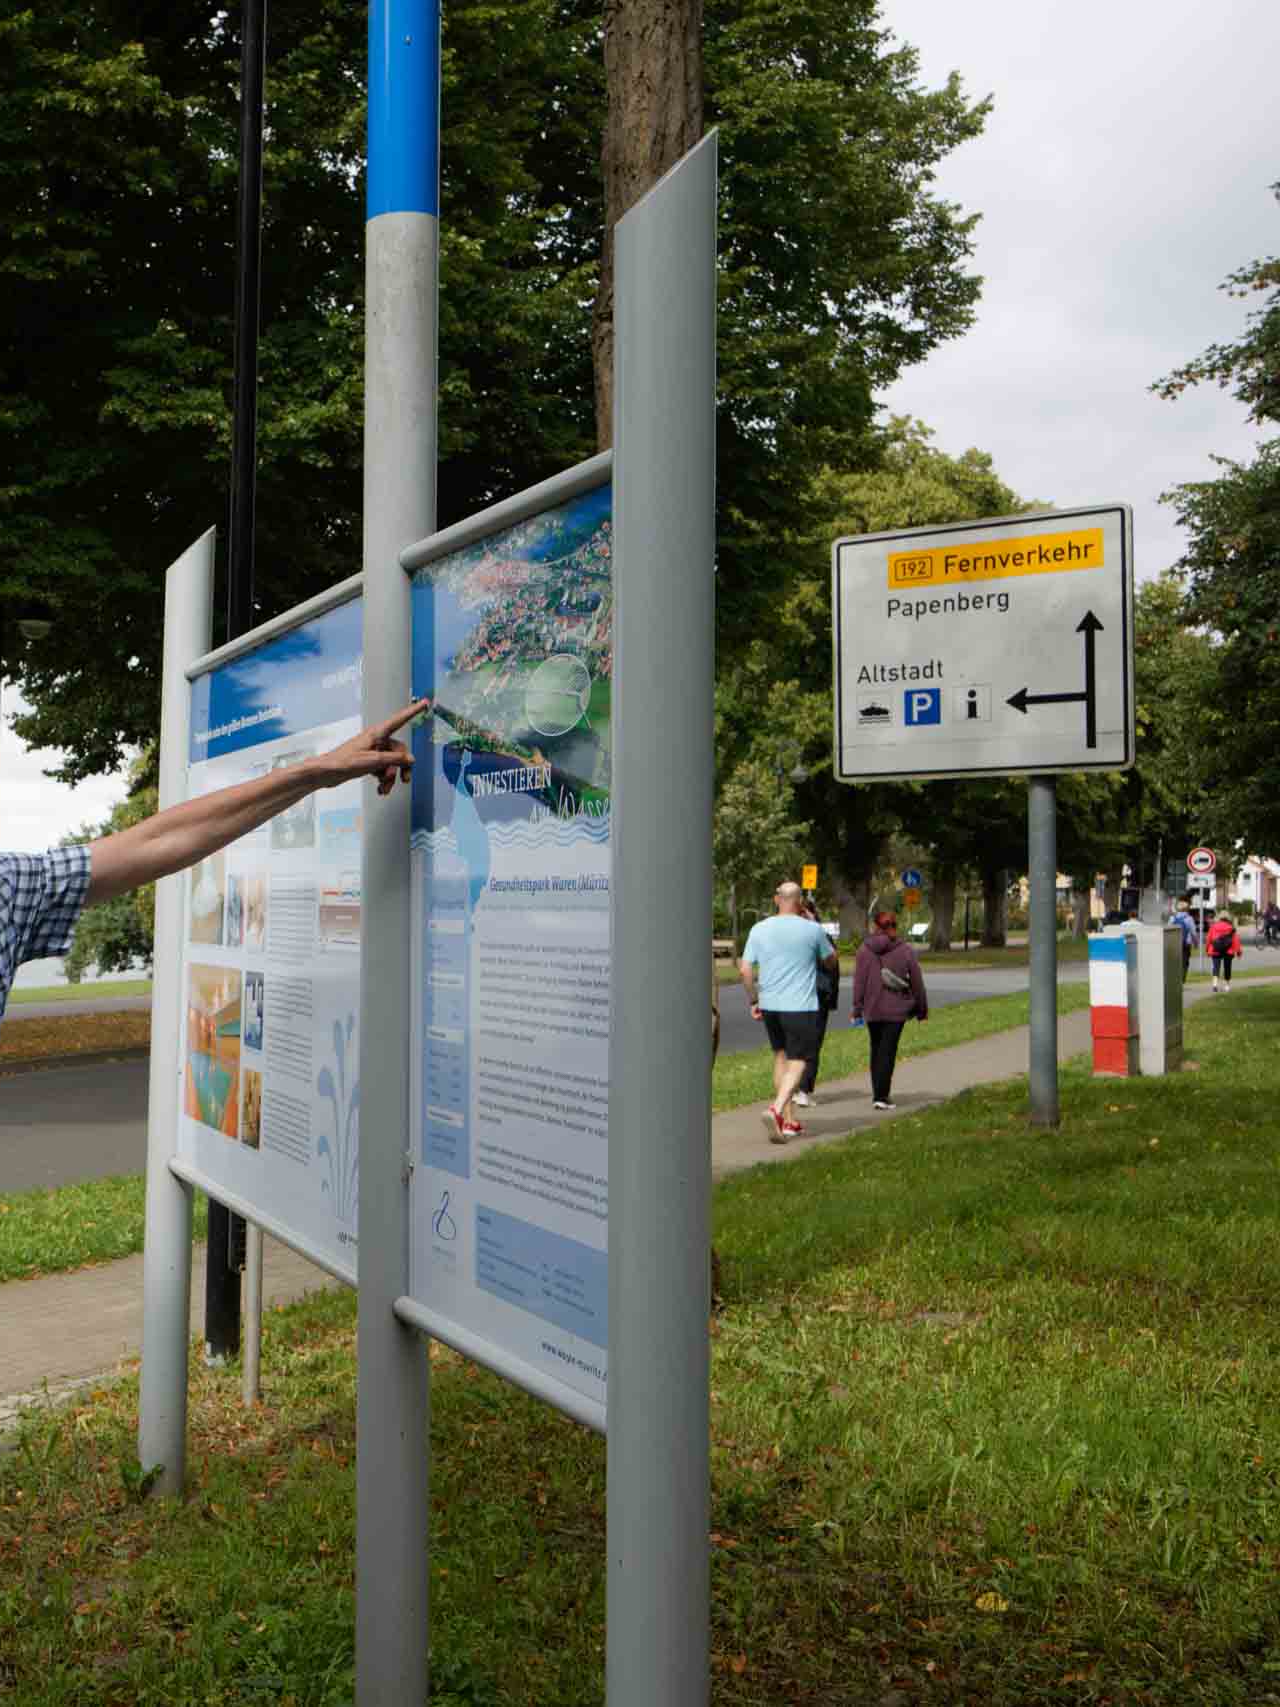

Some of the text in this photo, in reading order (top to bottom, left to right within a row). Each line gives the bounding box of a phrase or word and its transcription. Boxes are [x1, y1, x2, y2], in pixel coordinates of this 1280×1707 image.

[901, 540, 1095, 577] 192 Fernverkehr
[886, 592, 1010, 621] Papenberg
[856, 660, 944, 684] Altstadt
[911, 692, 934, 723] P
[472, 766, 552, 799] INVESTIEREN
